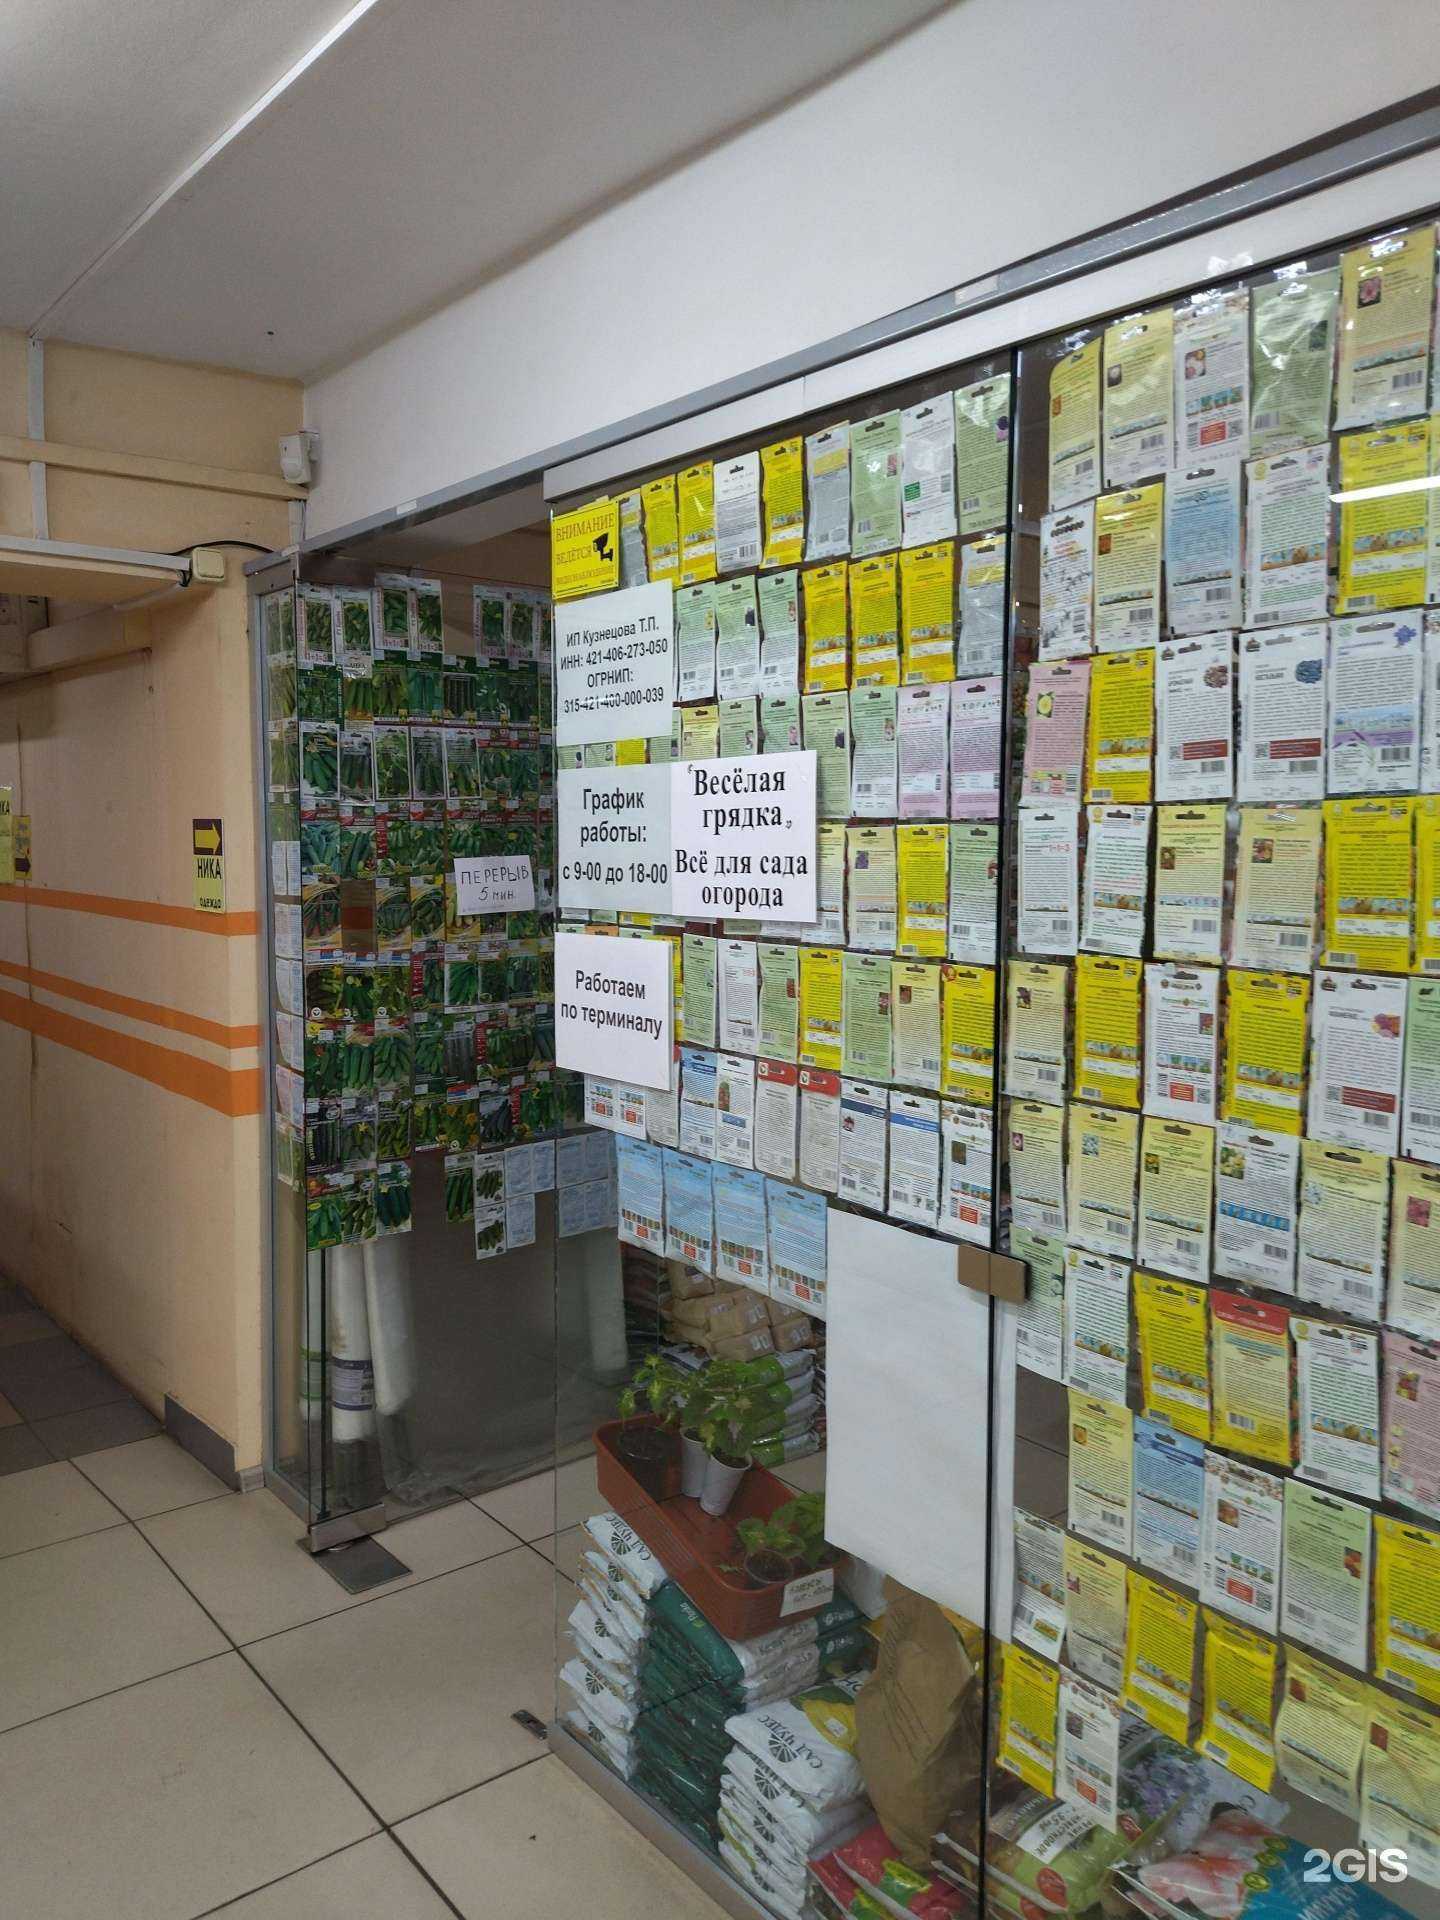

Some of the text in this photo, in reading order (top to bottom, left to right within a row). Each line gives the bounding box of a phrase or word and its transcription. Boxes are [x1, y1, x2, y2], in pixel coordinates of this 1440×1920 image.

[556, 513, 615, 542] ВНИМАНИЕ
[566, 616, 660, 647] ИП Кузнецова Т.П.
[560, 638, 668, 670] ИНН: 421-406-273-050
[587, 668, 634, 688] ОГРНИП:
[583, 788, 645, 815] График
[580, 820, 647, 847] работы:
[197, 858, 222, 879] НИКА
[461, 866, 529, 885] ПЕРЕРЫВ
[574, 861, 601, 881] 9-00
[605, 867, 623, 885] до
[629, 862, 668, 884] 18-00
[675, 849, 809, 876] Всё для сада
[479, 886, 489, 901] 5
[701, 887, 785, 913] огорода
[575, 969, 646, 1000] Работаем
[560, 1002, 663, 1040] по терминалу
